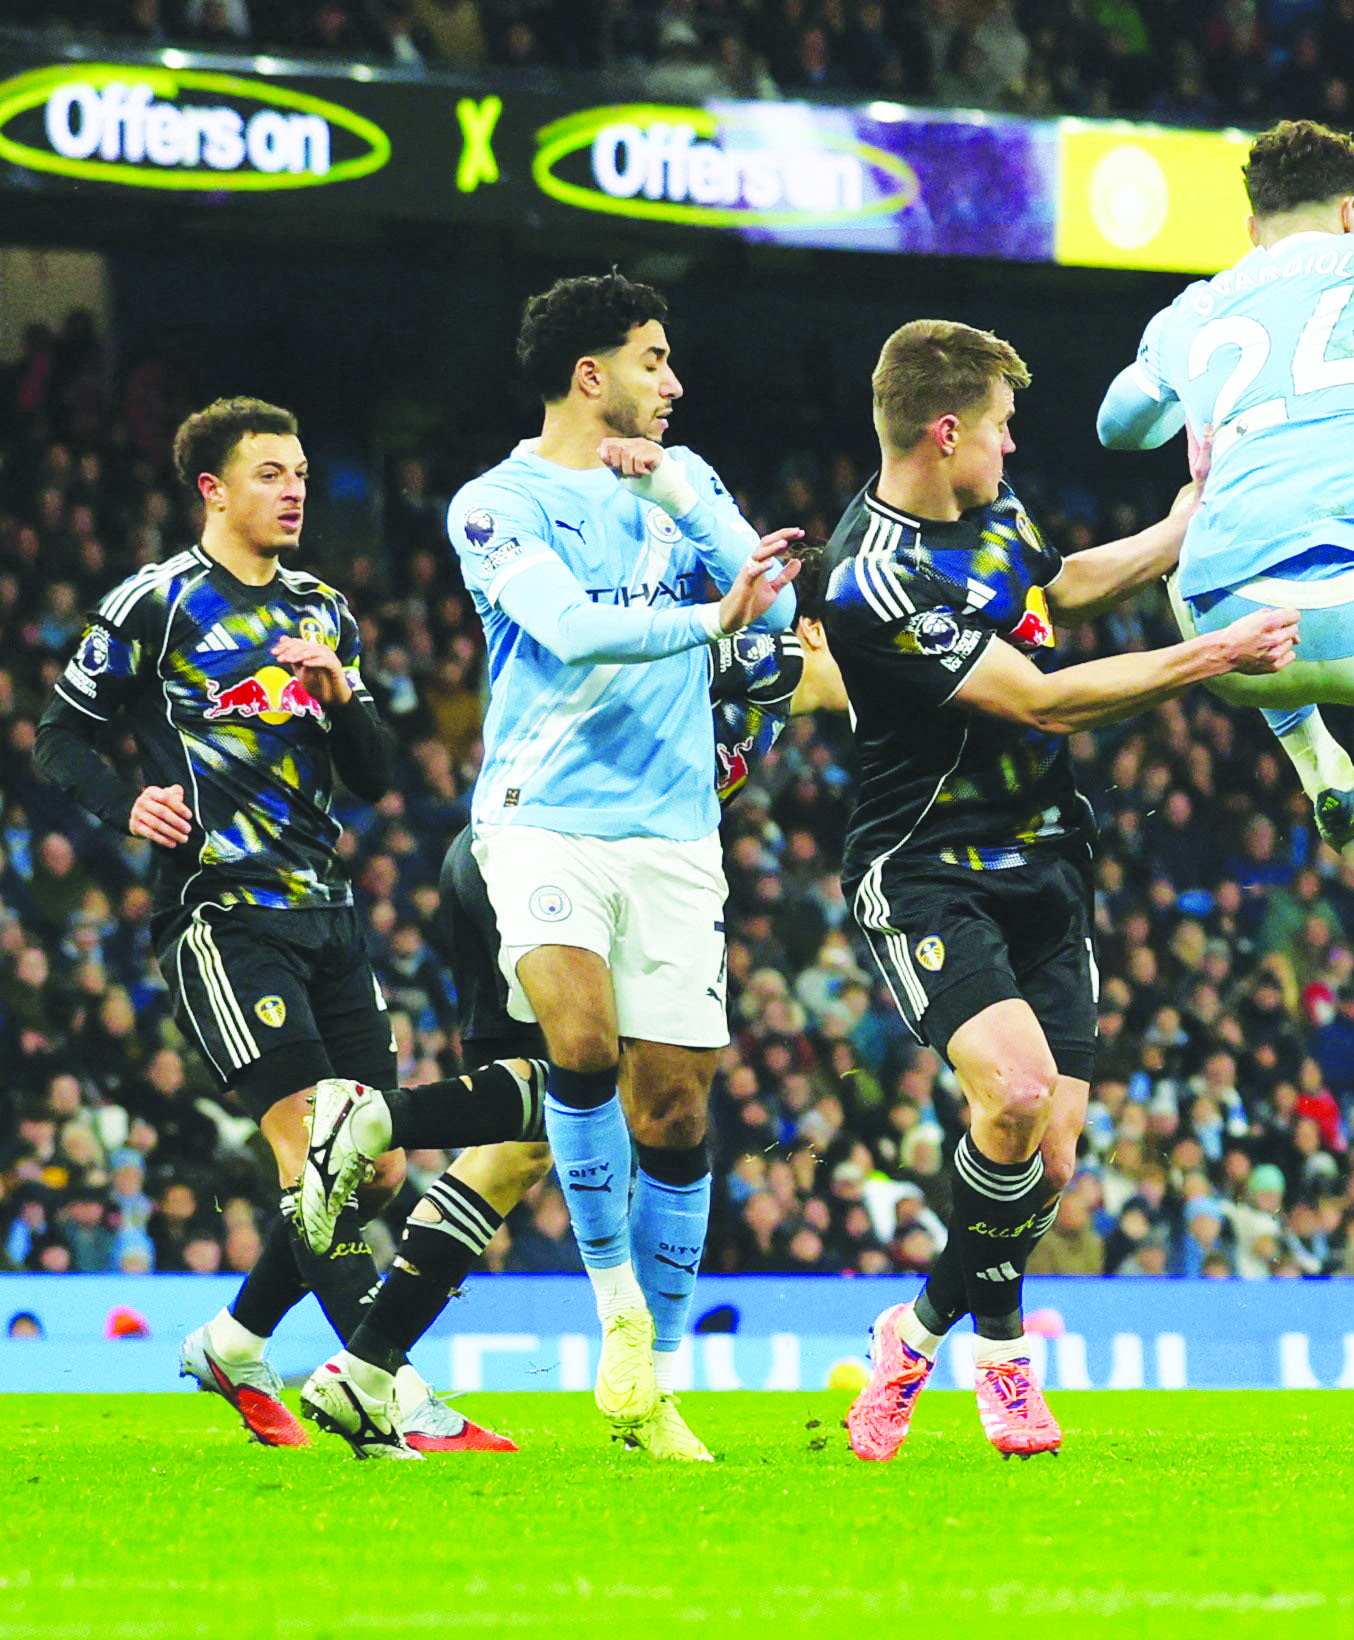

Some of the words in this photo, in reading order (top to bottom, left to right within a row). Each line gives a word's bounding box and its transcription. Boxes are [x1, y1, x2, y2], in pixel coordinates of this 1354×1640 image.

[44, 82, 245, 169] Offers
[247, 109, 330, 176] on
[584, 573, 698, 608] TIHA
